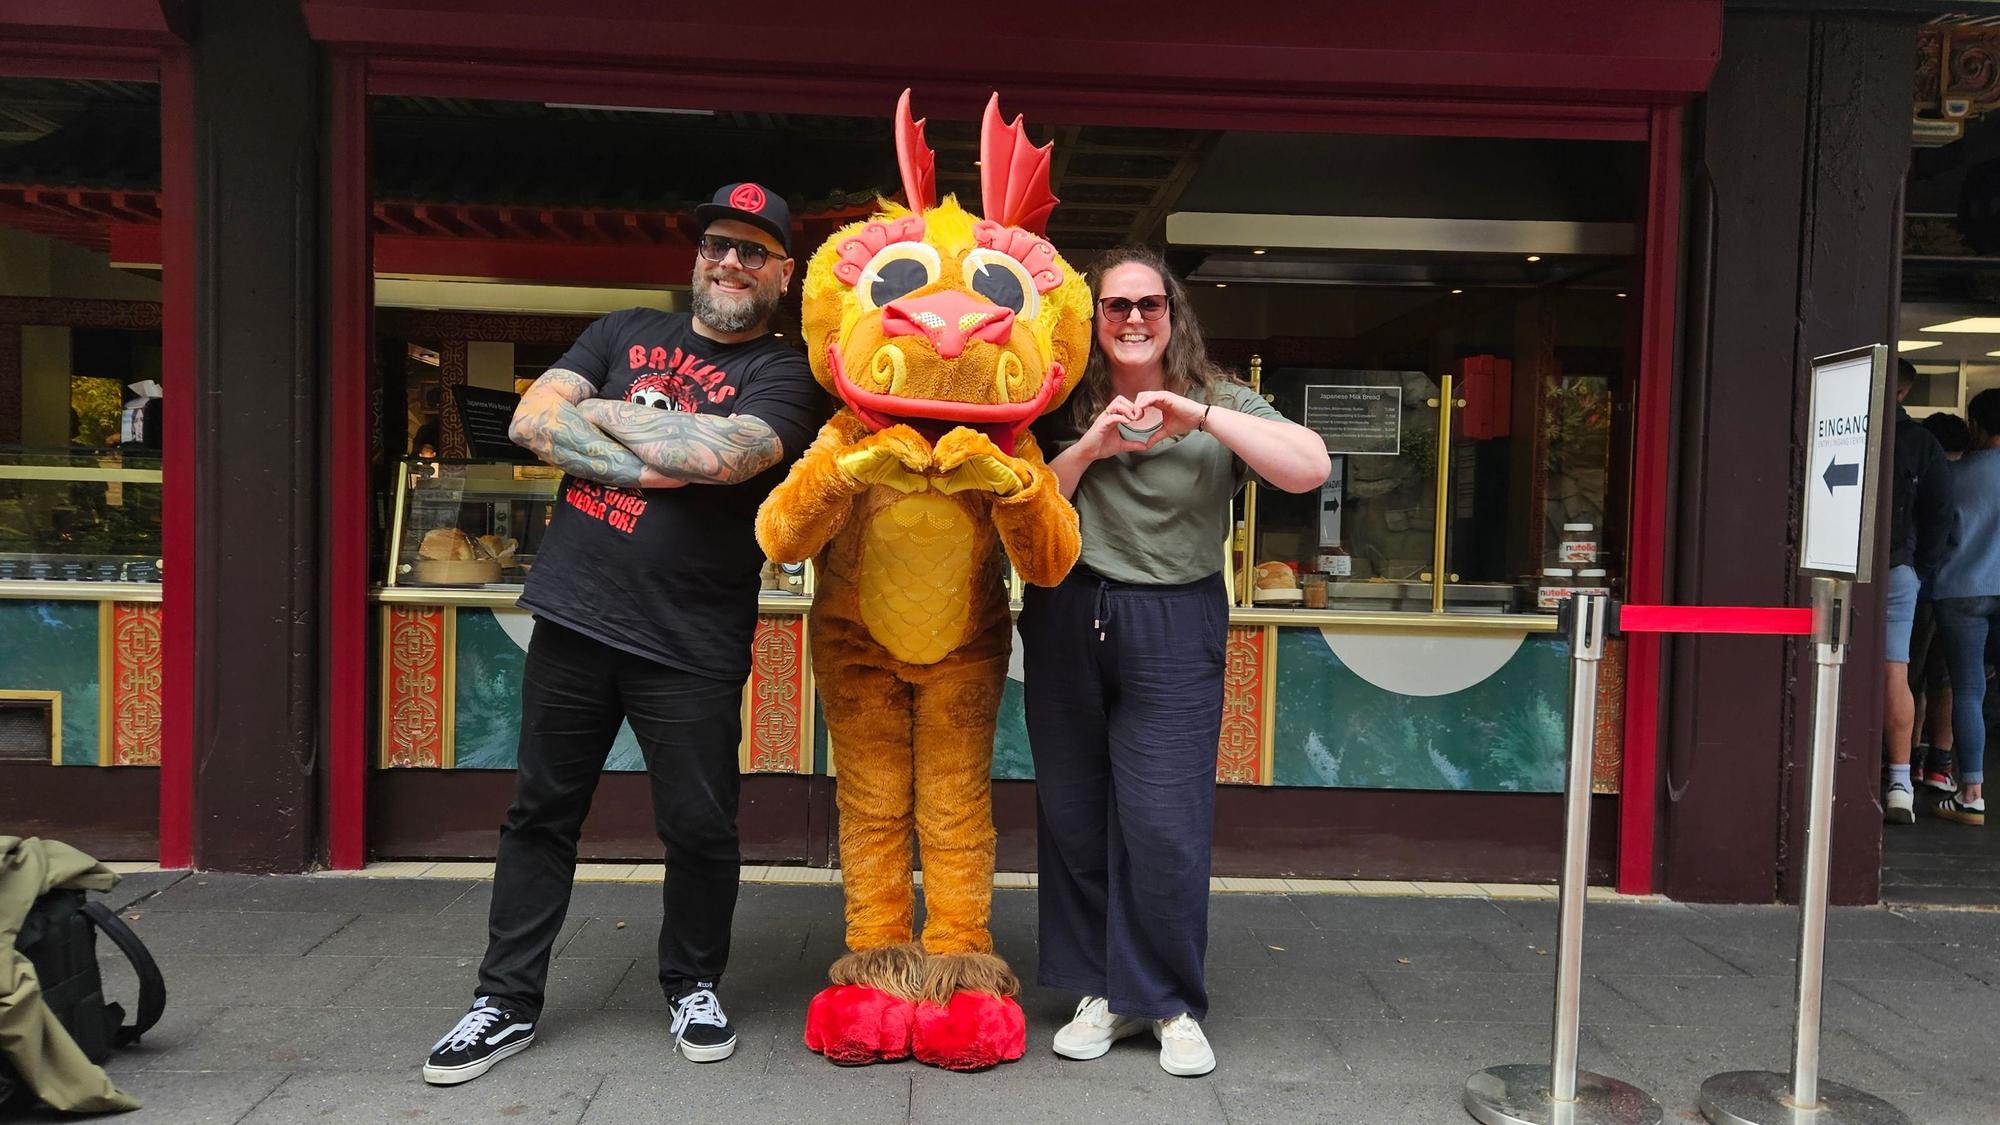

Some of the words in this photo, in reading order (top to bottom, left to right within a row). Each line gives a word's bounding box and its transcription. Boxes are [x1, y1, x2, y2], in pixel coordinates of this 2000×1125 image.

[566, 488, 607, 520] WIEDER
[608, 509, 638, 534] OK!
[604, 490, 646, 516] WIRD
